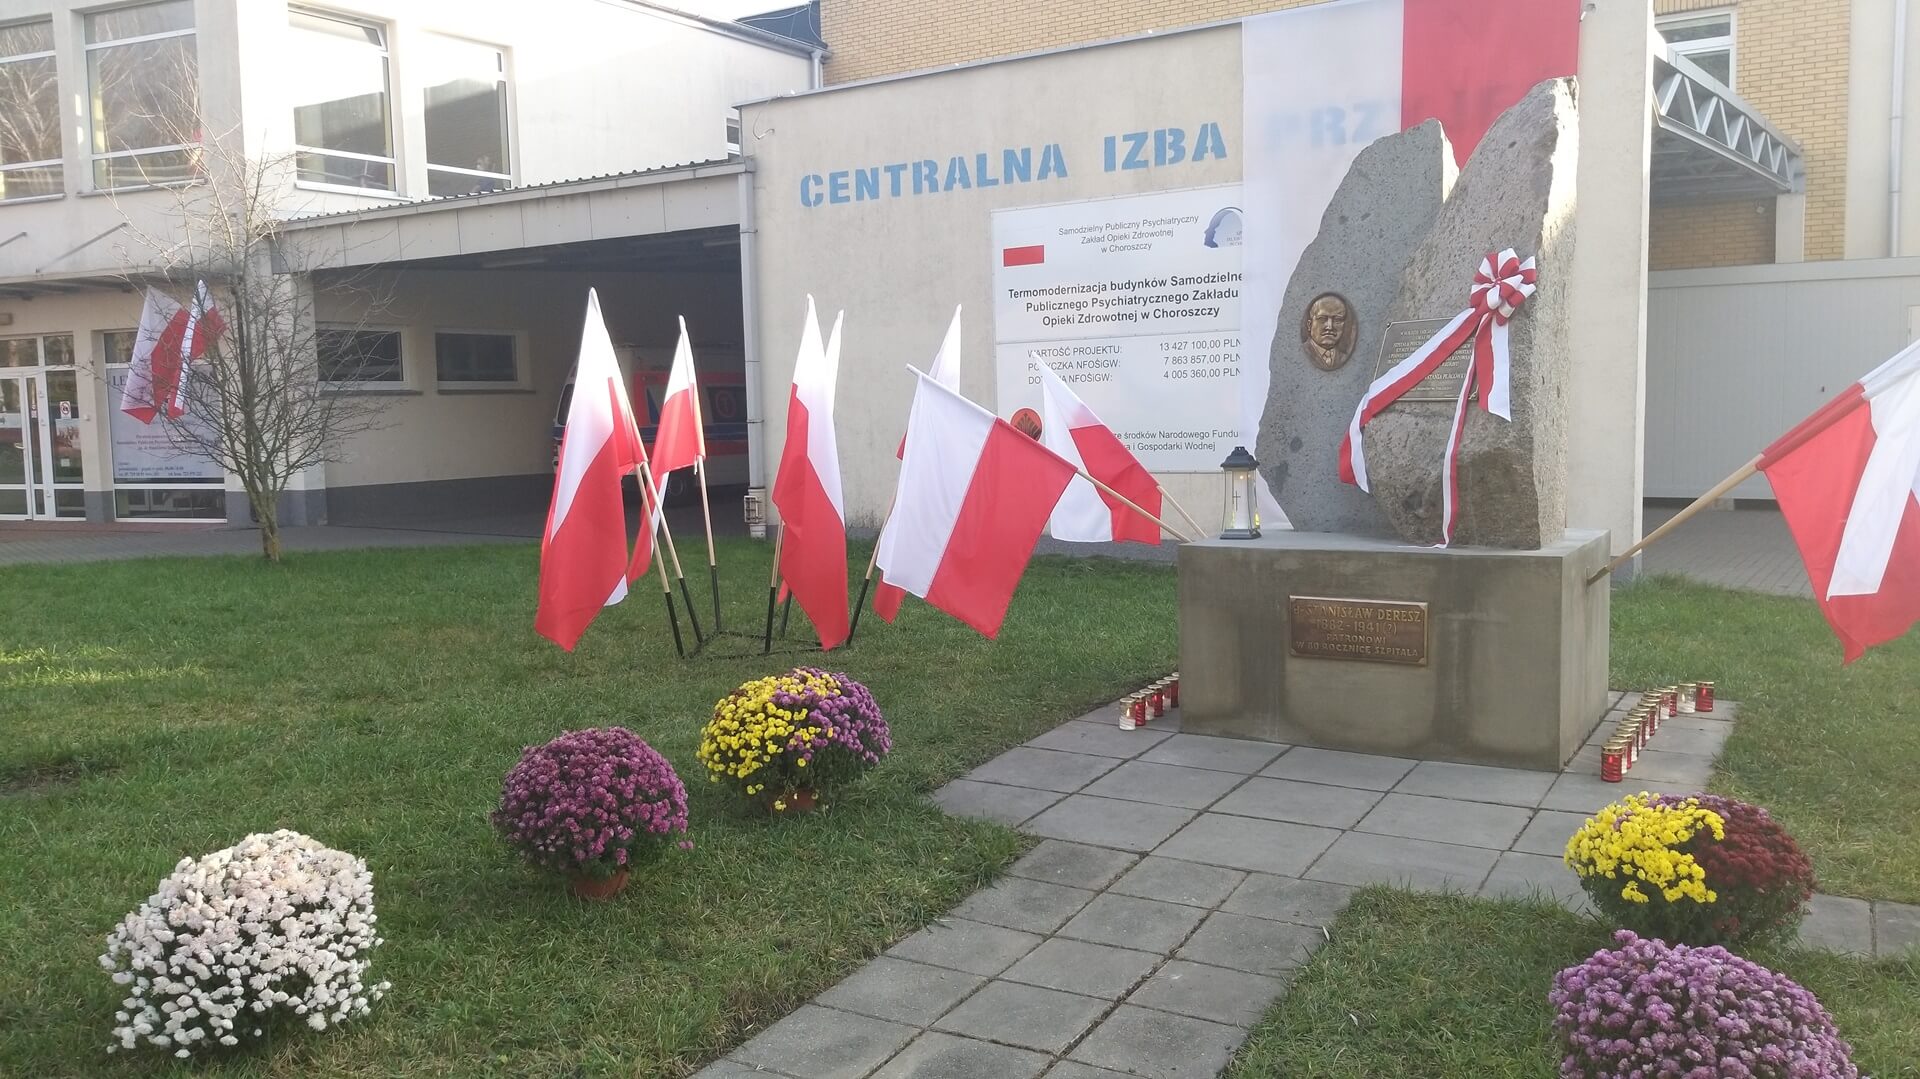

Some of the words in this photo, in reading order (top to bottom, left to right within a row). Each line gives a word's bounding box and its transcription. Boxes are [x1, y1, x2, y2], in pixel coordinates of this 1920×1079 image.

[800, 143, 1068, 207] CENTRALNA
[1103, 122, 1228, 173] IZBA
[1058, 224, 1104, 236] Samodzielny
[1105, 221, 1141, 231] Publiczny
[1142, 214, 1199, 227] Psychiatryczny
[1081, 235, 1105, 244] Zakład
[1107, 231, 1130, 242] Opieki
[1132, 228, 1174, 240] Zdrowotnej
[1109, 242, 1152, 253] Choroszczy
[1008, 281, 1107, 299] Termomodernizacja
[1110, 277, 1167, 292] budynków
[1170, 271, 1242, 287] Samodzielne
[1026, 300, 1088, 312] Publicznego
[1091, 293, 1189, 309] Psychiatrycznego
[1192, 288, 1239, 301] Zakładu
[1043, 314, 1075, 327] Opieki
[1078, 310, 1138, 324] Zdrowotnej
[1141, 311, 1150, 319] w
[1153, 306, 1220, 319] Choroszczy
[1072, 345, 1122, 355] PROJEKTU:
[1160, 342, 1169, 351] 13
[1172, 341, 1188, 350] 427
[1192, 339, 1220, 350] 100,00
[1164, 356, 1169, 365] 7
[1172, 355, 1188, 365] 863
[1190, 354, 1220, 364] 857,00
[1171, 370, 1188, 379] 005
[1190, 368, 1220, 378] 360,00
[1124, 431, 1156, 440] środków
[1158, 430, 1210, 440] Narodowego
[1212, 430, 1239, 438] Fundu
[1137, 442, 1182, 452] Gospodarki
[1185, 442, 1216, 451] Wodnej
[1377, 608, 1421, 622] DERESZ
